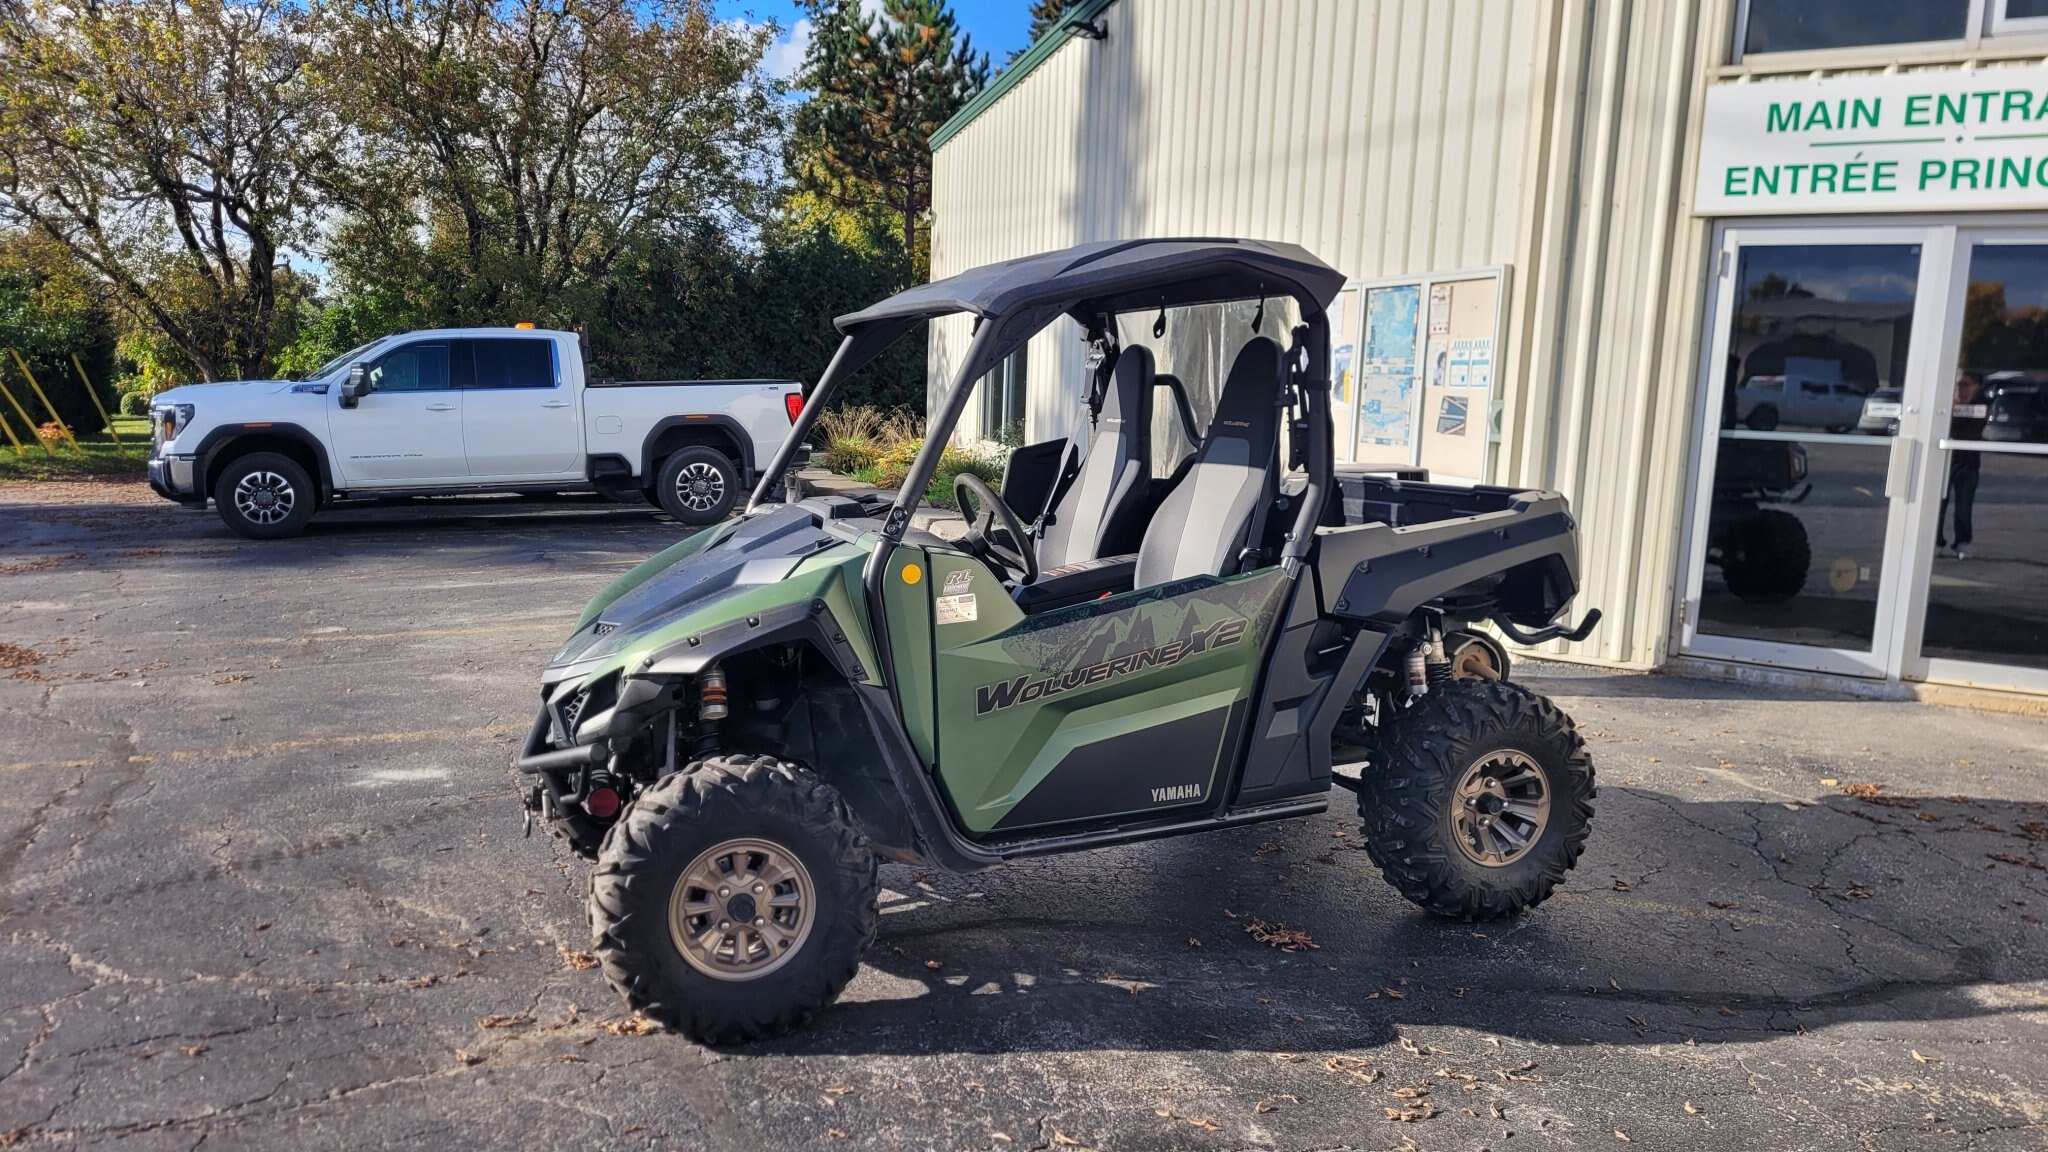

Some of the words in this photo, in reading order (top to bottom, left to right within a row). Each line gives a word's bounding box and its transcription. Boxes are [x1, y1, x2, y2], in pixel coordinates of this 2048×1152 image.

[1766, 97, 1881, 133] MAIN
[1724, 151, 1899, 196] ENTRÉE
[1151, 783, 1201, 802] YAMAHA
